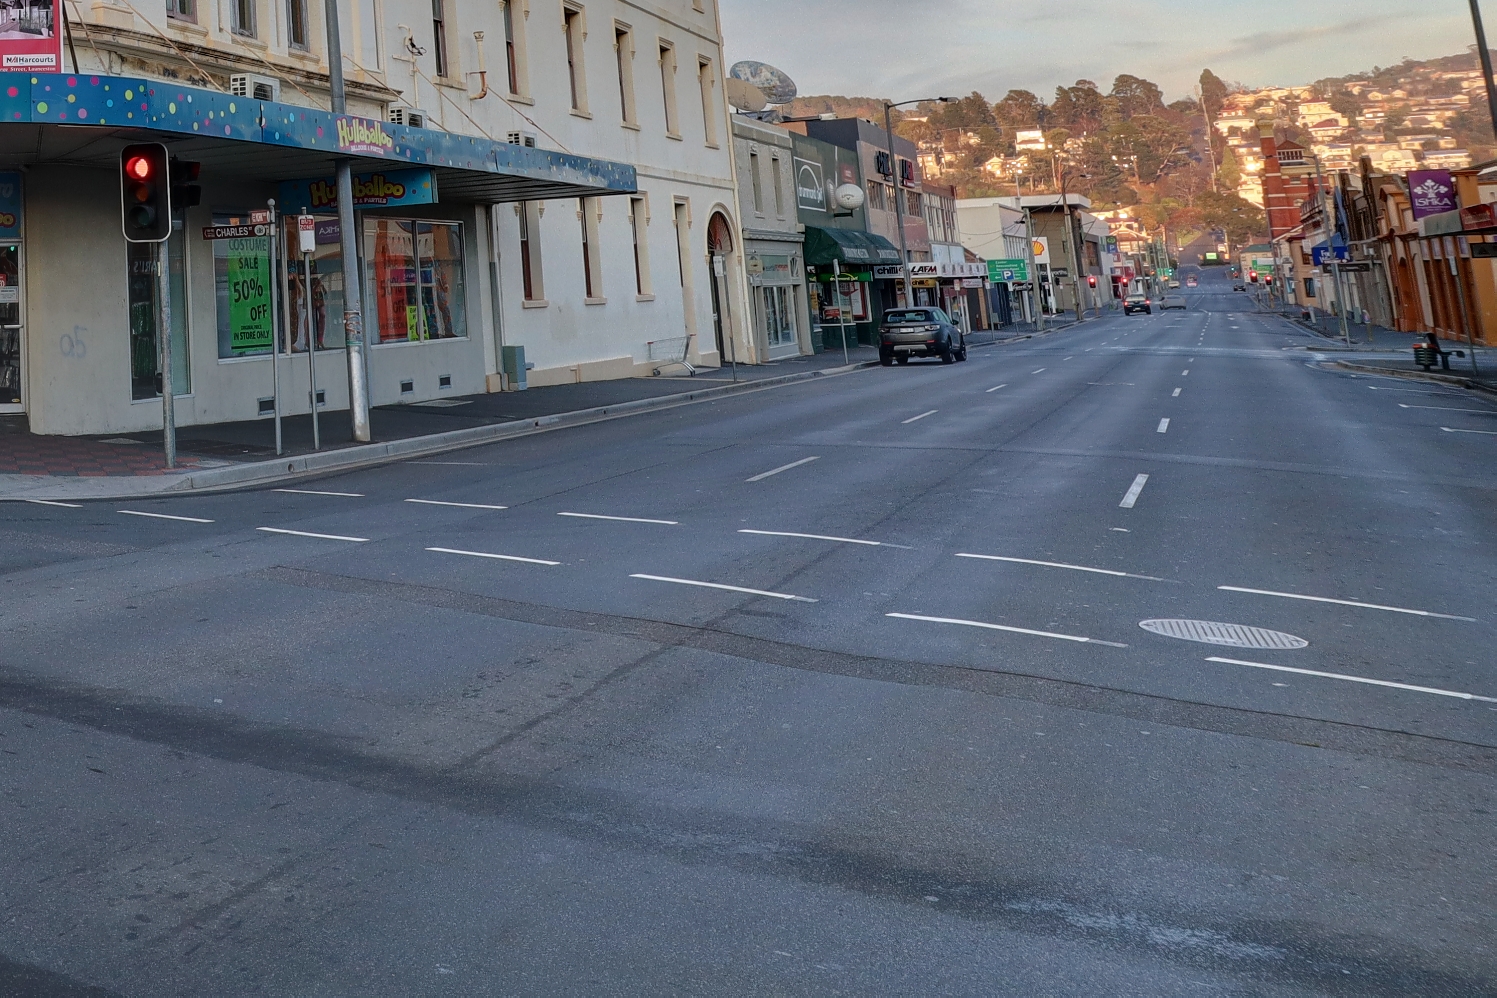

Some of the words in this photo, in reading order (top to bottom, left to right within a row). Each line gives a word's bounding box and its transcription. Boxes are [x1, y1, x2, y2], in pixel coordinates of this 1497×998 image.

[336, 118, 393, 148] Hullaballoo
[309, 175, 404, 206] Huballoo
[1415, 197, 1452, 207] ISHKA
[216, 226, 249, 238] CHARLES
[229, 238, 267, 251] COSTUME
[238, 257, 258, 270] SALE
[911, 265, 937, 273] LAFM
[877, 266, 898, 275] chilli
[233, 276, 263, 303] 50%
[250, 304, 267, 321] OFF
[233, 331, 239, 341] IN
[240, 330, 256, 340] STORE
[256, 330, 270, 339] ONLY
